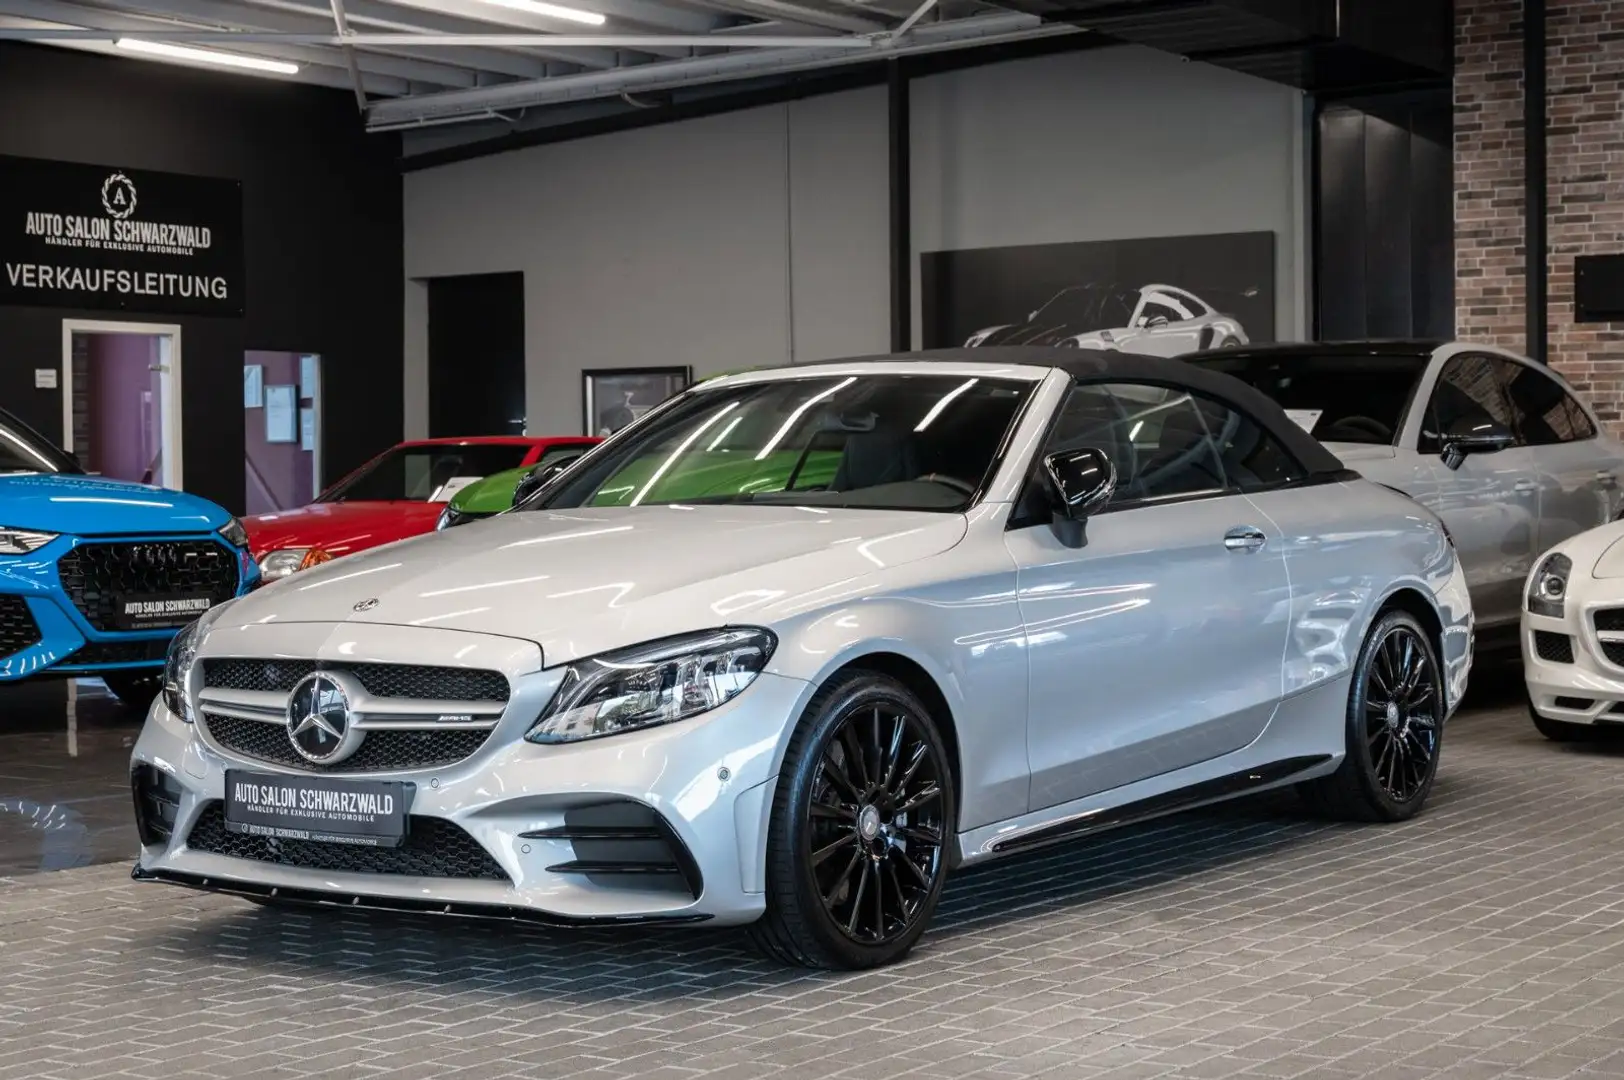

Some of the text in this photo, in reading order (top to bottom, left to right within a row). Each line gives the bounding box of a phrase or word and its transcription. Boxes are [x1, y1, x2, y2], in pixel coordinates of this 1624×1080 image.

[113, 187, 126, 205] A
[25, 211, 211, 249] AUTO SALON SCHWARZWALD
[45, 236, 194, 256] HÄNDLER FÜR EXKLUSIVE AUTOMOBILE
[6, 262, 228, 299] VERKAUFSLEITUNG
[125, 598, 210, 614] AUTO SALON SCHWARZWALD
[234, 782, 394, 815] AUTO SALON SCHWARZWALD
[247, 804, 375, 822] HÄNDLER FÜR EXKLUSIVE AUTOMOBILE
